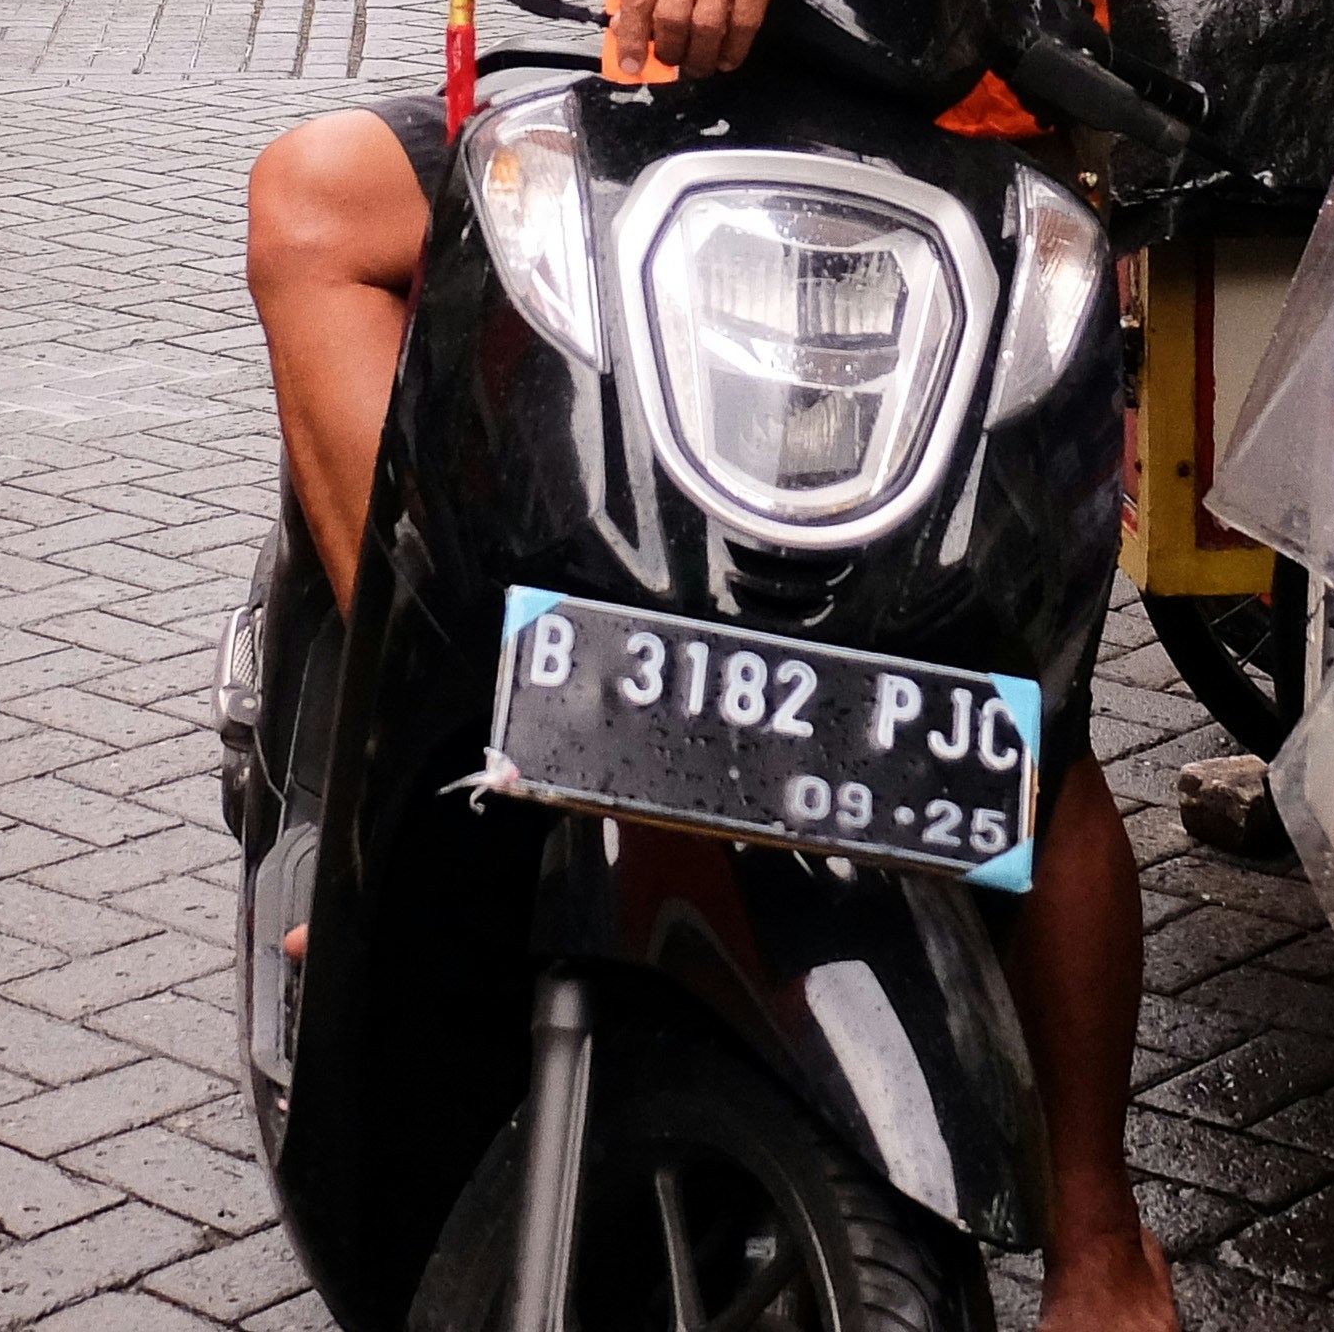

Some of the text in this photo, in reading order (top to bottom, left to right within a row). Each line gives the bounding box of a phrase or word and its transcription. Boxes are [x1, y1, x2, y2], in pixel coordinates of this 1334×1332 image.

[529, 615, 1019, 769] B 3182 PJC
